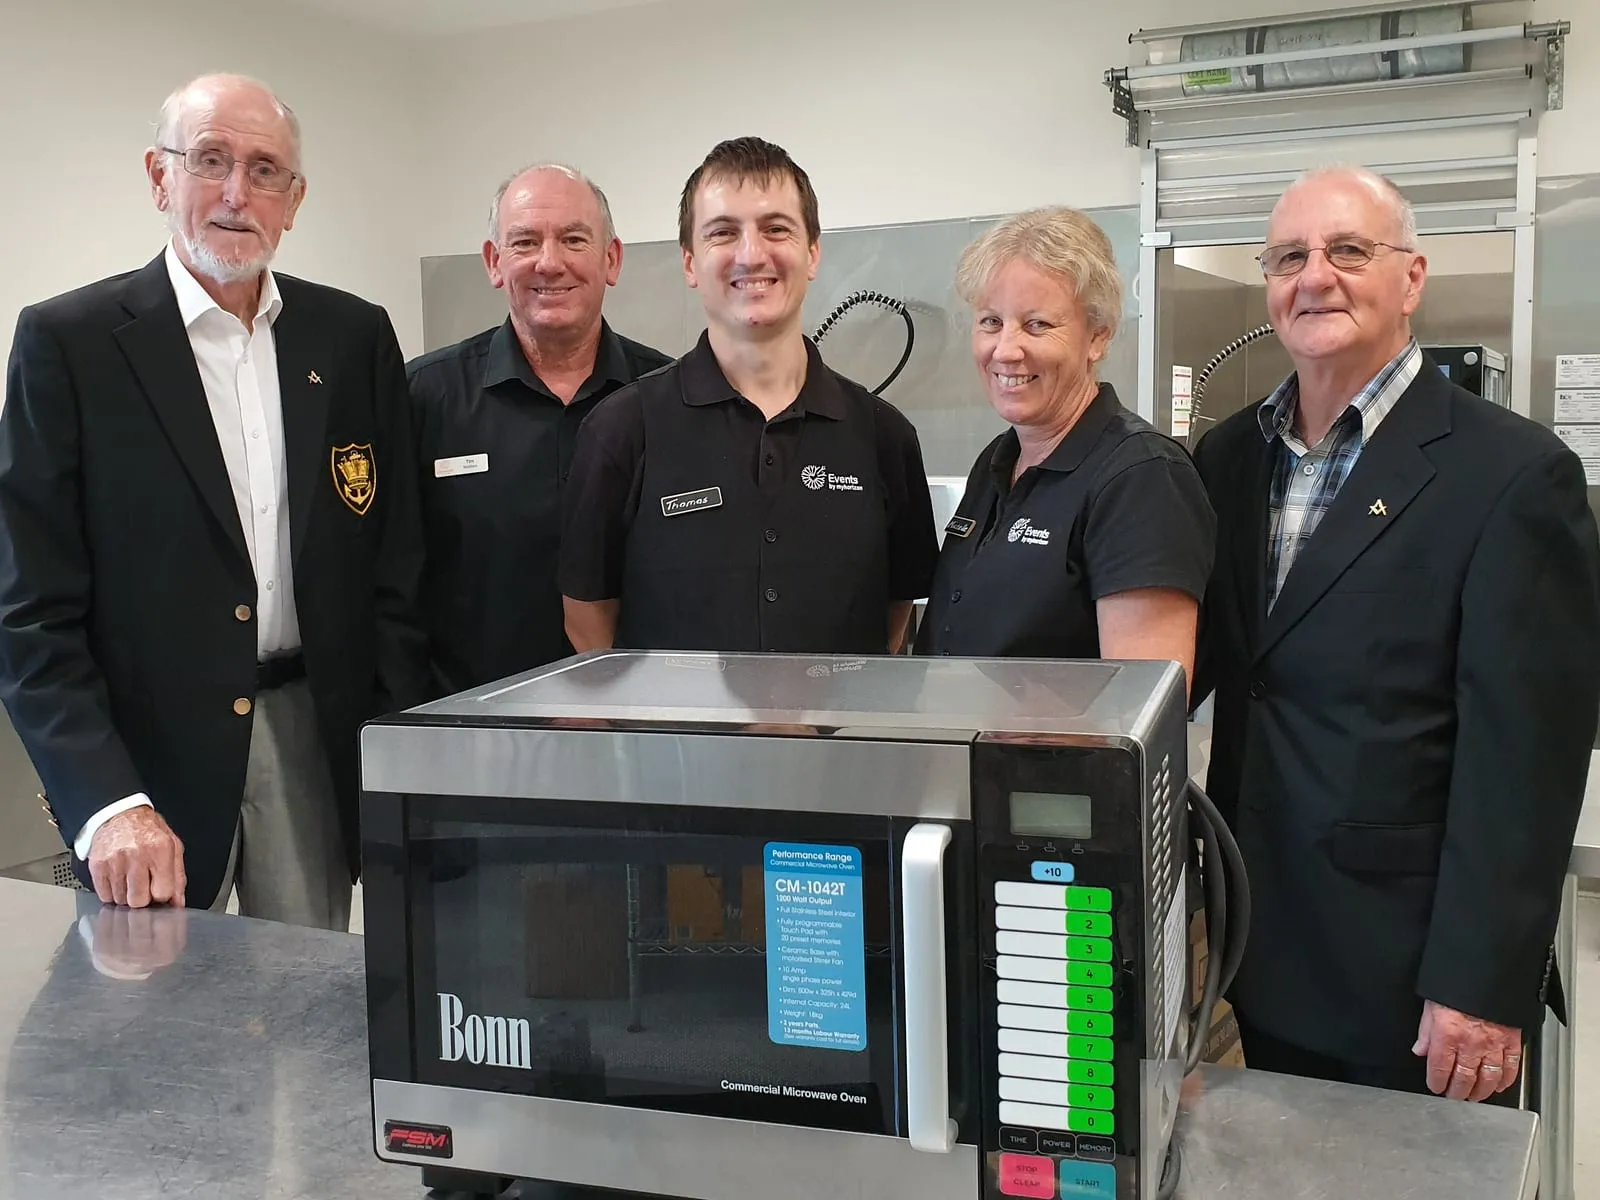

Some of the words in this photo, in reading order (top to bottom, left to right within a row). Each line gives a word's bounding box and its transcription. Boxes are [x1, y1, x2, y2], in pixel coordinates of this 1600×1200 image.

[828, 474, 858, 484] Events
[666, 496, 708, 510] Thomas
[1024, 526, 1050, 539] Events
[772, 850, 823, 860] Performance
[826, 852, 852, 863] Range
[770, 859, 805, 867] Commercial
[806, 861, 838, 869] Microwave
[1044, 867, 1062, 877] +10
[776, 878, 846, 896] CM-1042T
[809, 897, 832, 905] Output
[792, 907, 817, 915] Stainless
[795, 920, 842, 928] programmable
[1085, 920, 1092, 929] 2
[782, 946, 808, 954] Ceramic
[1086, 945, 1093, 953] 3
[1086, 969, 1093, 978] 4
[783, 998, 806, 1006] Internal
[1086, 994, 1093, 1003] 5
[1087, 1020, 1093, 1028] 6
[437, 993, 532, 1070] Bonn
[834, 1031, 859, 1040] Warranty
[1087, 1044, 1093, 1052] 7
[1087, 1068, 1094, 1077] 8
[721, 1080, 780, 1095] Commercial
[783, 1086, 837, 1101] Microwave
[840, 1092, 867, 1104] Oven
[1087, 1093, 1094, 1102] 9
[1088, 1117, 1094, 1126] 0
[390, 1129, 447, 1148] FSM
[1010, 1135, 1027, 1144] TIME
[1043, 1139, 1071, 1149] POWER
[1079, 1144, 1111, 1152] MEMORY
[1016, 1165, 1038, 1173] STOP
[1013, 1179, 1040, 1187] CLEAR
[1075, 1178, 1100, 1187] START
